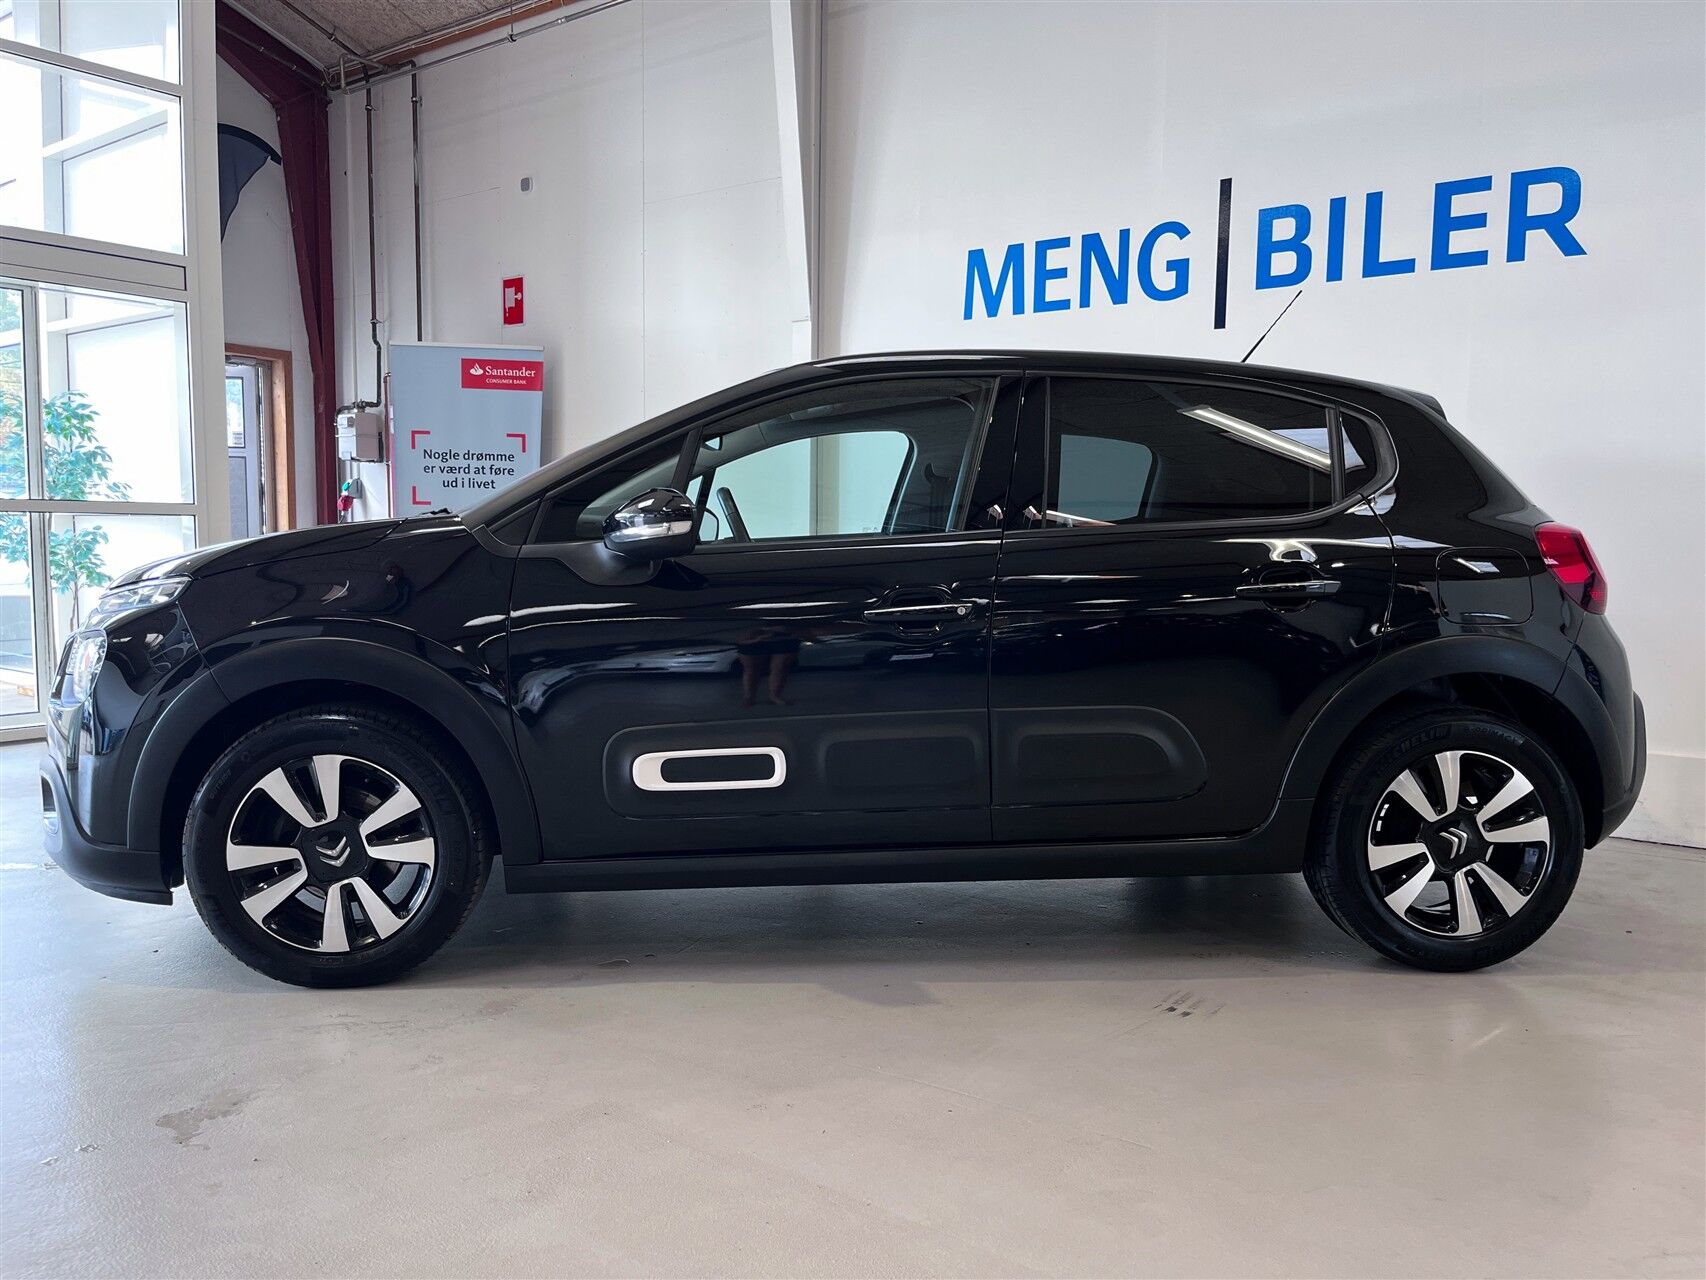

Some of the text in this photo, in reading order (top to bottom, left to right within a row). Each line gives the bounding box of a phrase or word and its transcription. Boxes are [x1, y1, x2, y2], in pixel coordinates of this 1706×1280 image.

[964, 166, 1587, 320] MENG BILER
[485, 365, 536, 377] Santander
[423, 448, 515, 463] Nogle drømme
[423, 463, 515, 476] er værd at føre
[442, 477, 496, 489] ud i livet
